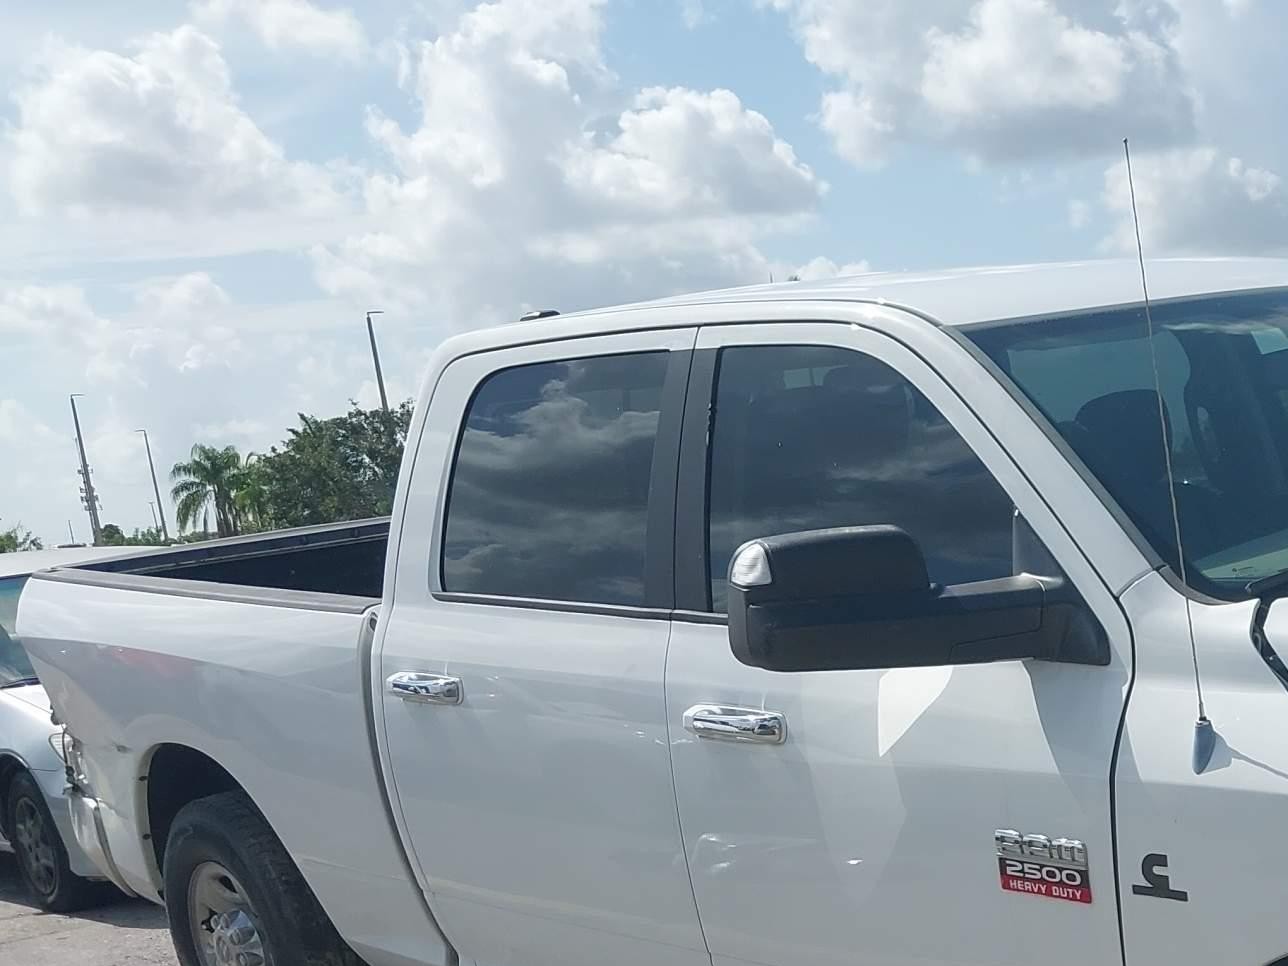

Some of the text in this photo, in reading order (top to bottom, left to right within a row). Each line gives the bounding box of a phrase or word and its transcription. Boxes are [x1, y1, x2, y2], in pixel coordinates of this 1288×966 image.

[1005, 860, 1081, 886] 2500
[1009, 879, 1081, 900] HEAVY DUTY
